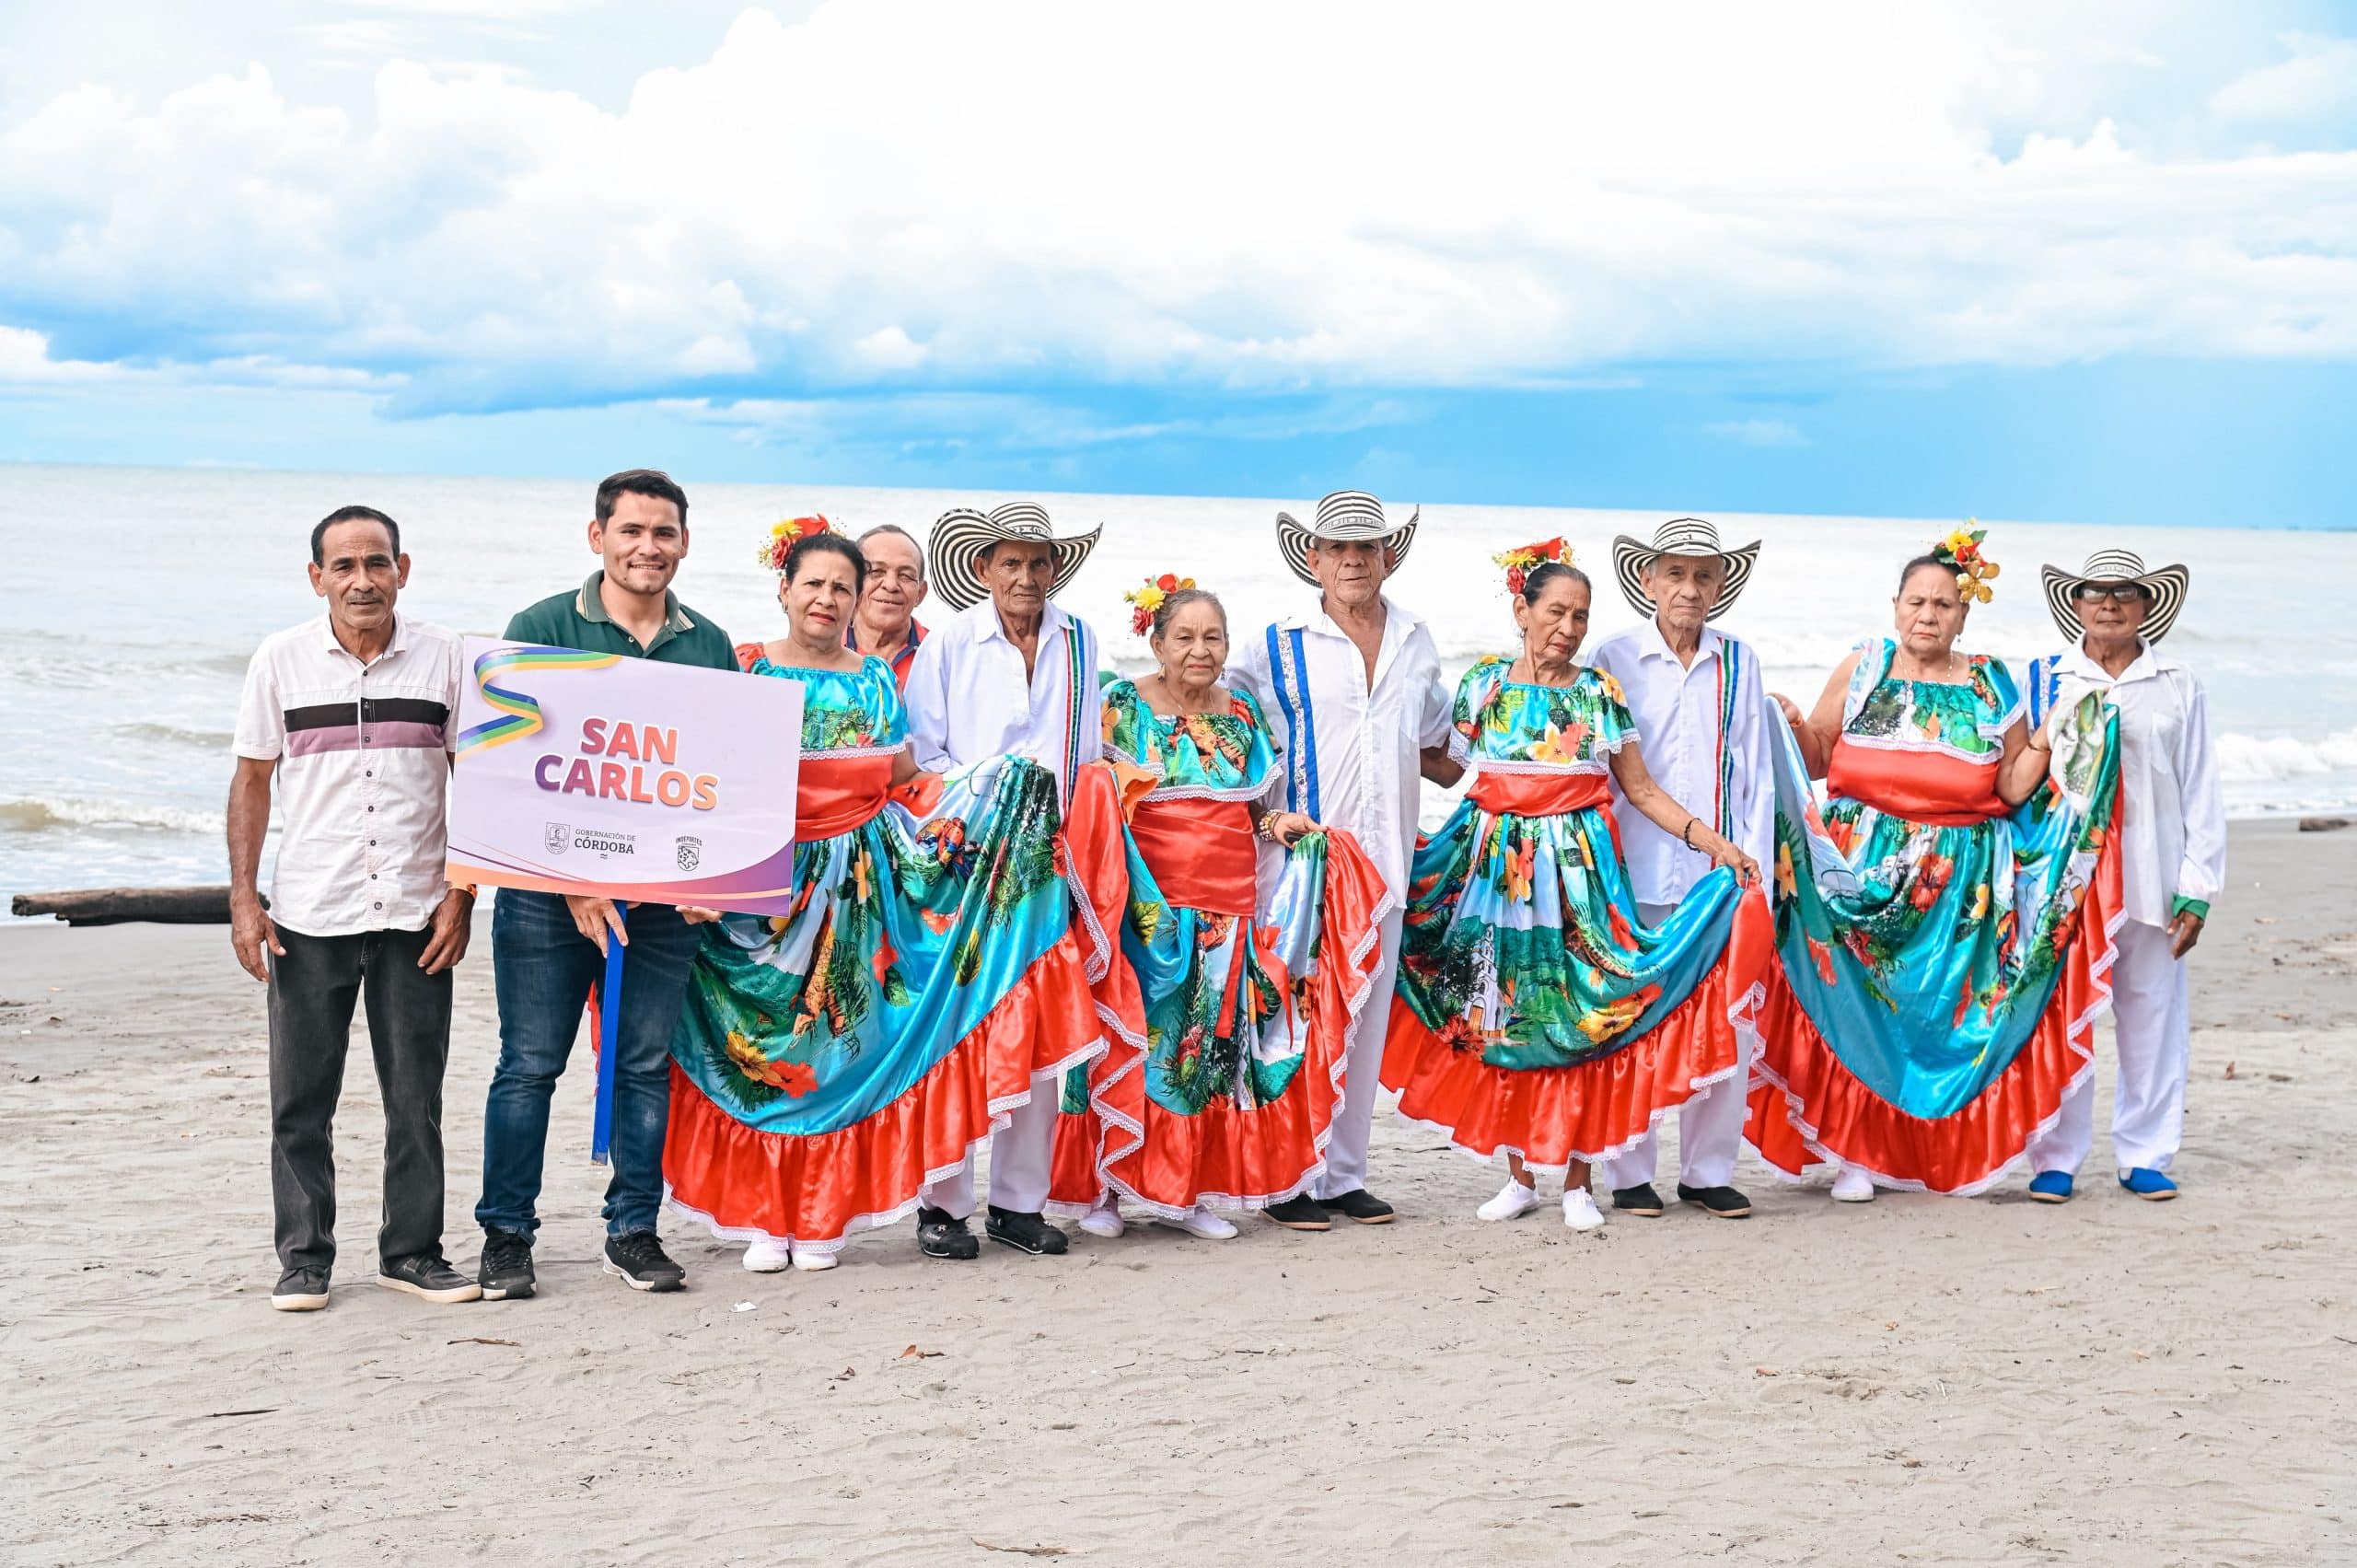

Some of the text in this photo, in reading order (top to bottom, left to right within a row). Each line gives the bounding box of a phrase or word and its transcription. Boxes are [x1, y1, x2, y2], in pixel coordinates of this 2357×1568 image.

[580, 718, 679, 765] SAN
[534, 754, 719, 810] CARLOS
[575, 829, 624, 840] GOBERNACIÓN
[575, 837, 634, 854] CÓRDOBA
